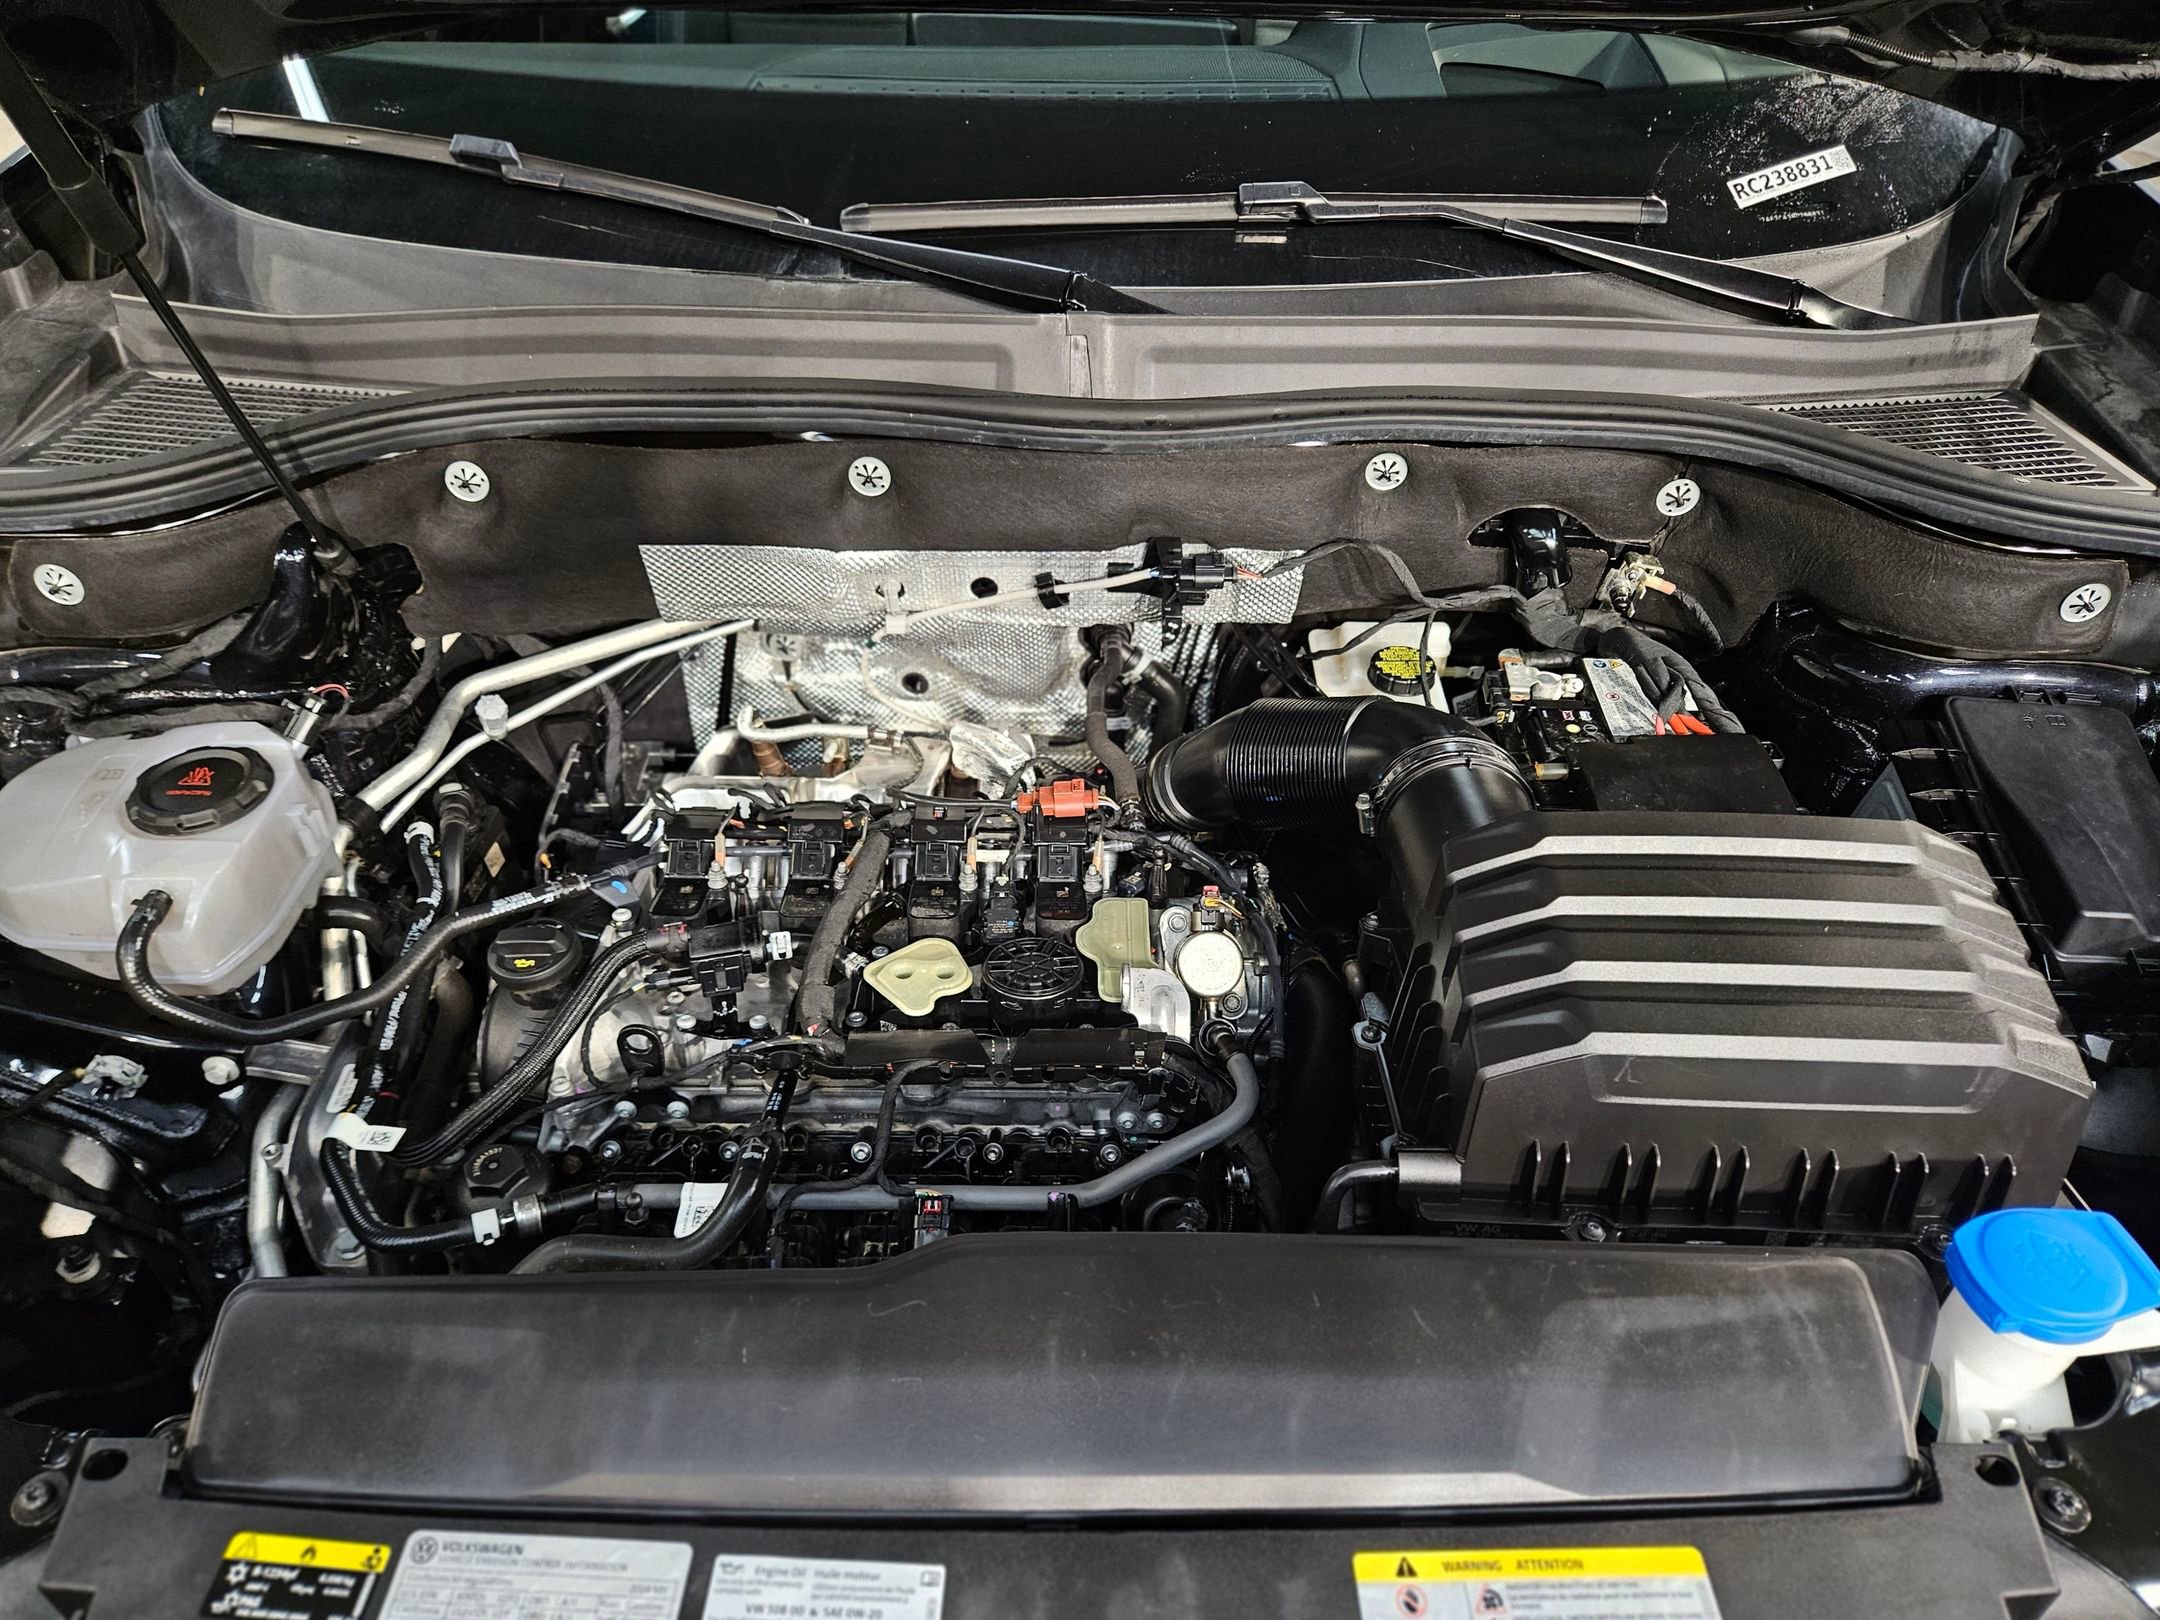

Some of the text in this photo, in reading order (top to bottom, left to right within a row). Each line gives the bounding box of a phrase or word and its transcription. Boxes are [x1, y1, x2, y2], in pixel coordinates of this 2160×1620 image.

[1732, 155, 1833, 199] RC238831
[441, 1541, 525, 1556] VOLKSWAGEN
[755, 1565, 807, 1578] Engine Oil
[1441, 1558, 1584, 1573] WARNING ATTENTION
